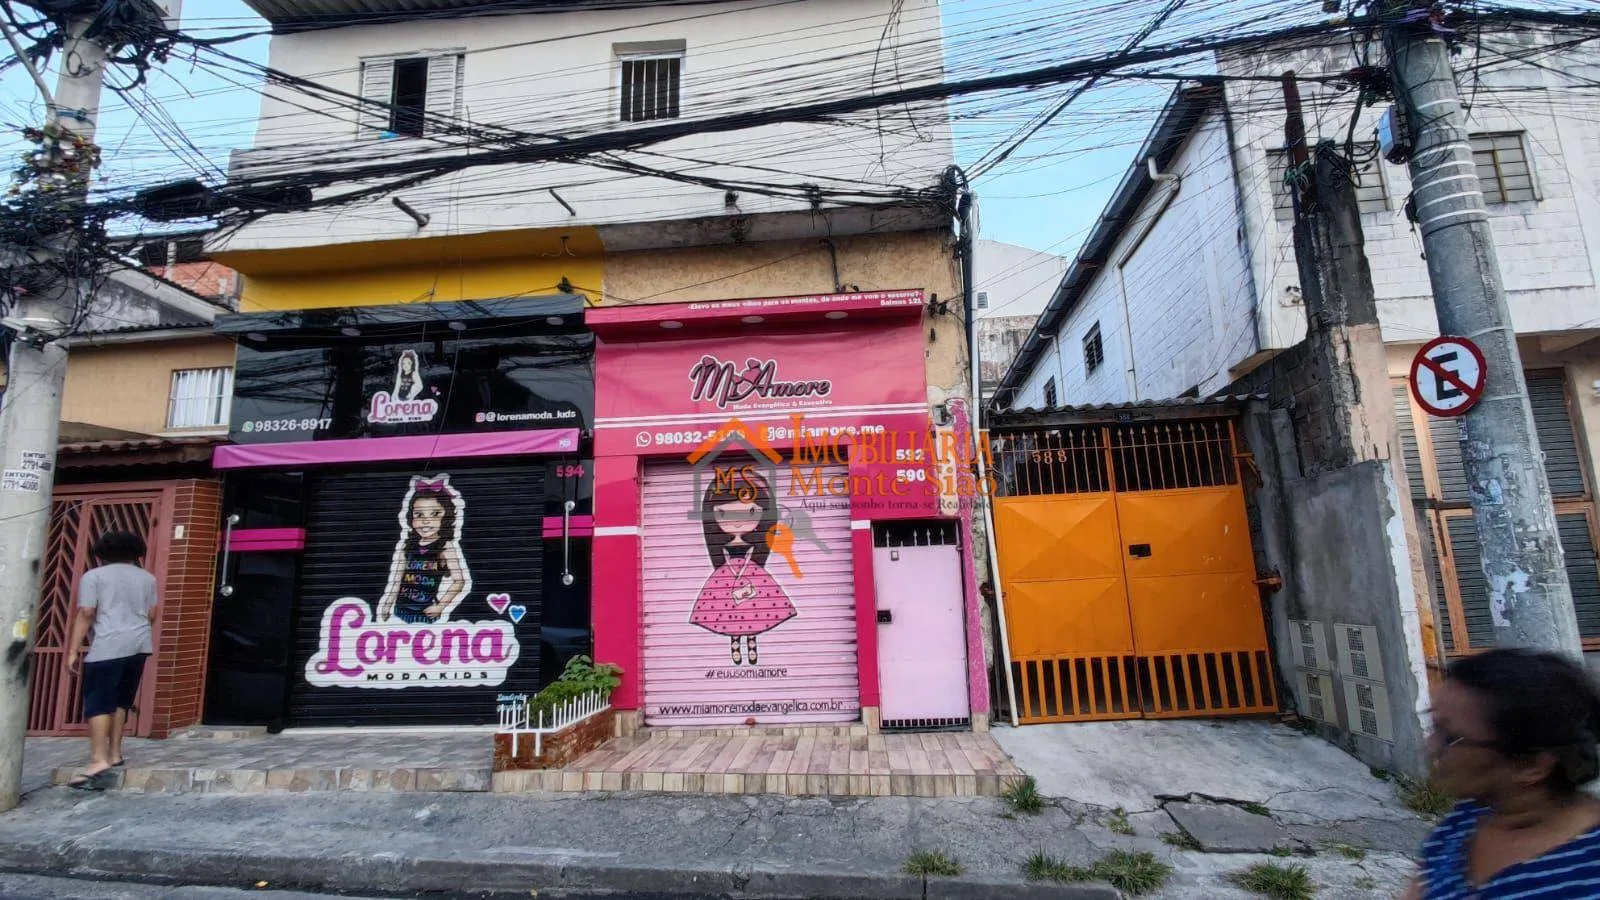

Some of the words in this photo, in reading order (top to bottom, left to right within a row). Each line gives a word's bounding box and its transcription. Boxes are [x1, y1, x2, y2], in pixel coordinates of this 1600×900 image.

[371, 393, 432, 420] Lorena
[254, 418, 332, 432] 98326-8917
[895, 448, 926, 461] 592
[1032, 449, 1067, 464] 588
[895, 468, 926, 482] 590
[315, 603, 512, 677] Lorena
[367, 673, 428, 681] MODA
[440, 671, 488, 679] KIDS
[659, 698, 844, 715] www.miamoremodaevangelica.com.br
